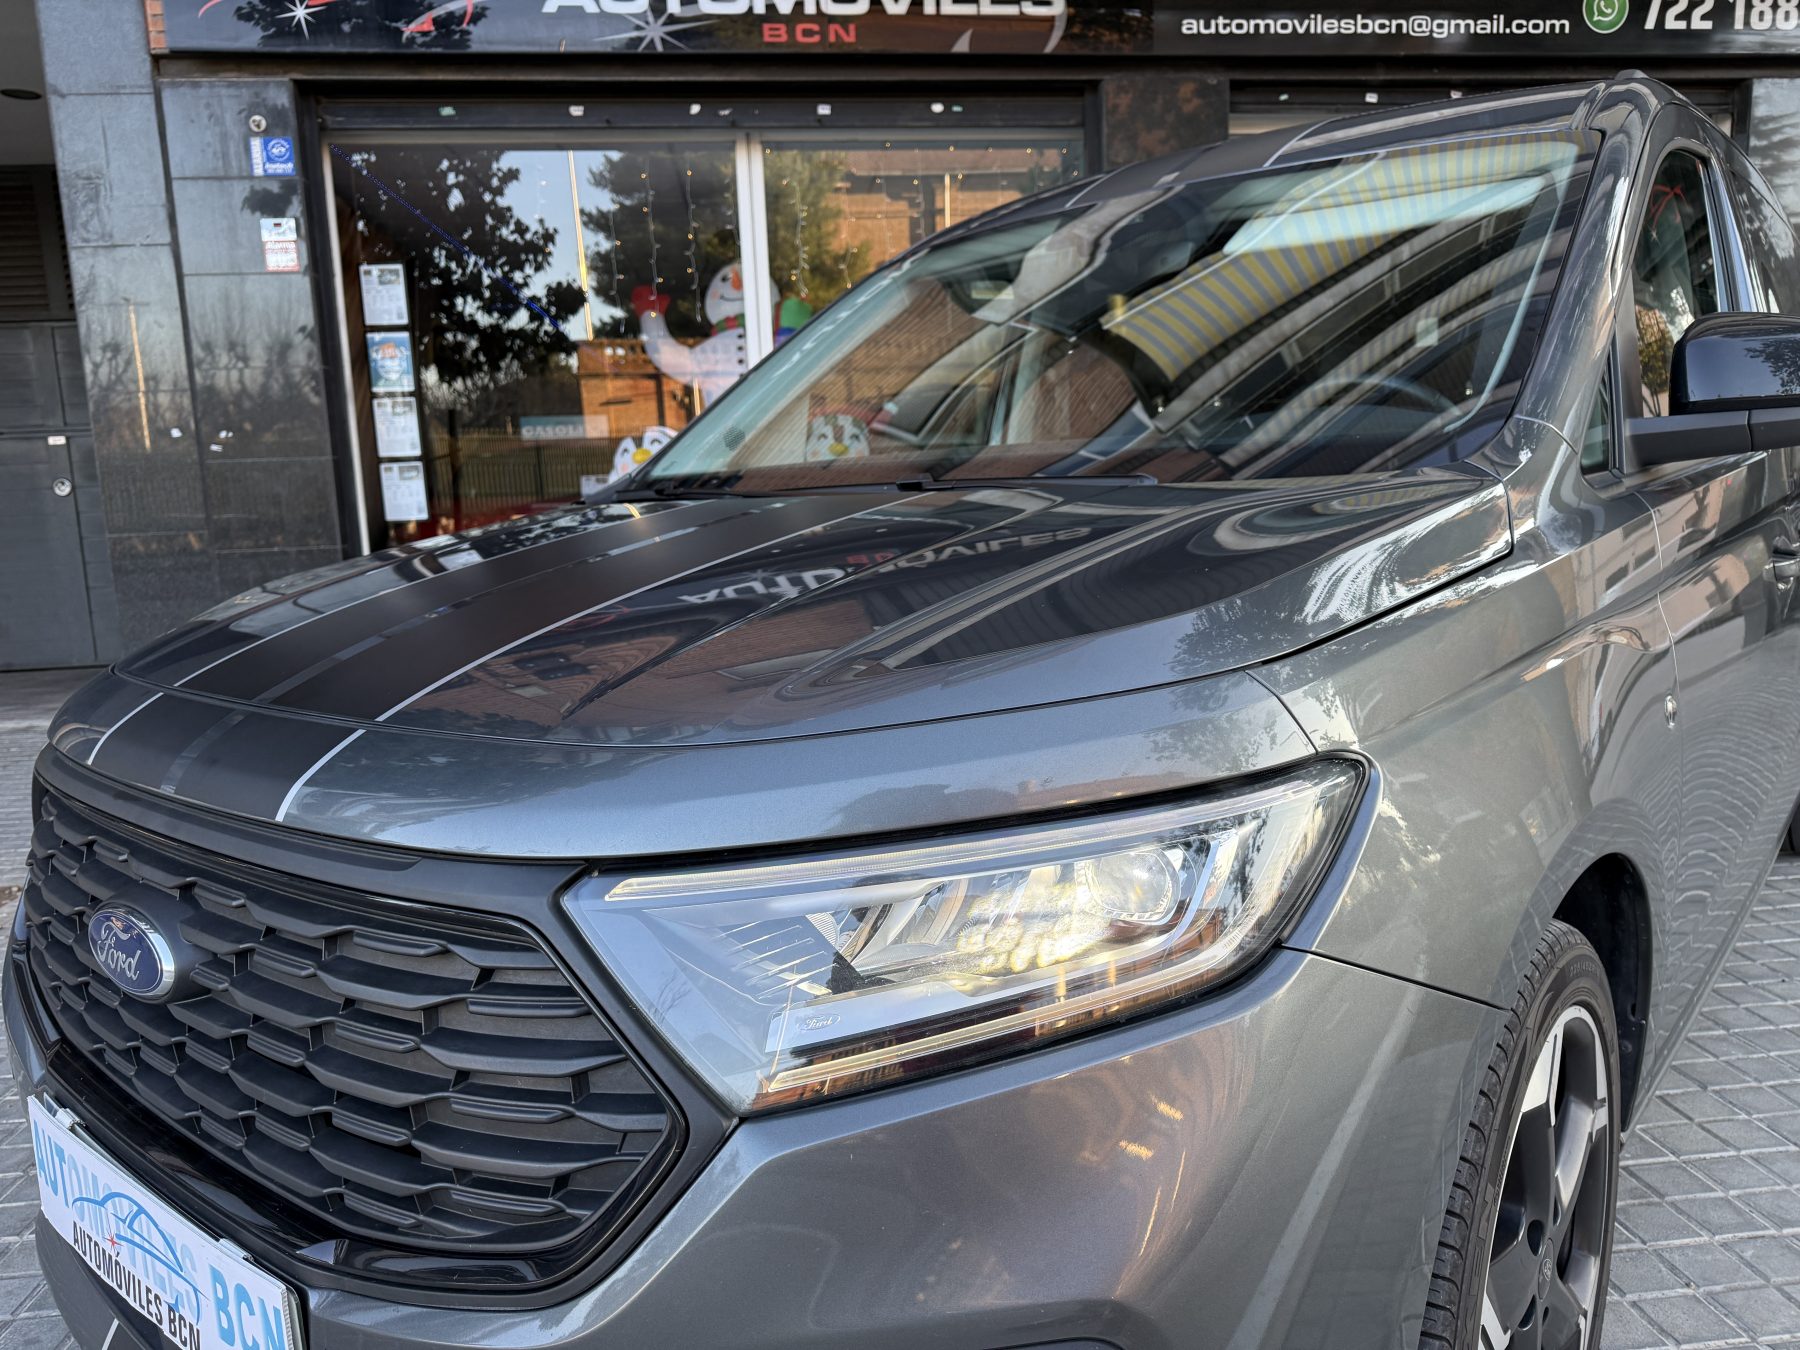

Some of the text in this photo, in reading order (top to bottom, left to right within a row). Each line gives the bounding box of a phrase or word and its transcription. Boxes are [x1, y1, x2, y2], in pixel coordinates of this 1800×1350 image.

[762, 22, 857, 44] BCN
[1181, 14, 1570, 39] automovilesbcn@gmail.com
[97, 921, 142, 981] Ford
[73, 1220, 200, 1350] AUTOMÓVILES BCN
[208, 1263, 287, 1350] BCN
